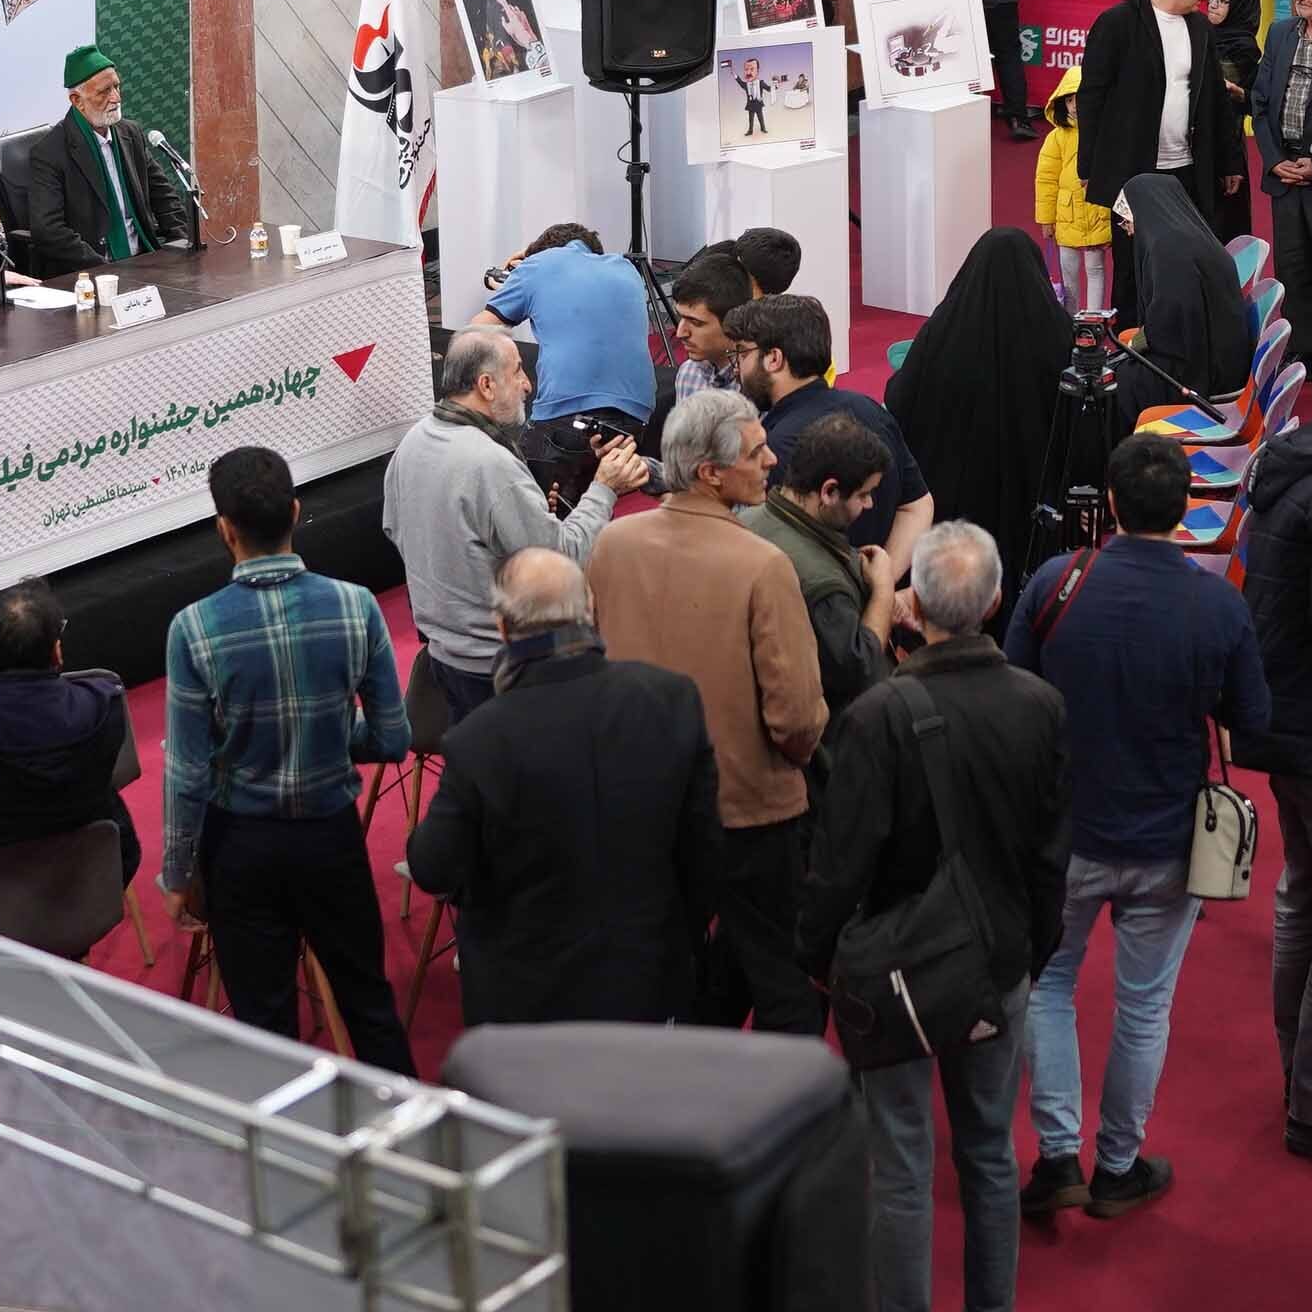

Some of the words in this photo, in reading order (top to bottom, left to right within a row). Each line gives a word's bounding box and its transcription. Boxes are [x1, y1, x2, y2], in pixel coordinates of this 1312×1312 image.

[202, 365, 322, 428] چهاردهمین
[110, 402, 201, 458] جشنواره
[37, 432, 108, 483] مردمی
[190, 459, 206, 474] ماه
[72, 487, 117, 517] فلسطین
[116, 480, 148, 500] سینما
[42, 503, 72, 527] تهران
